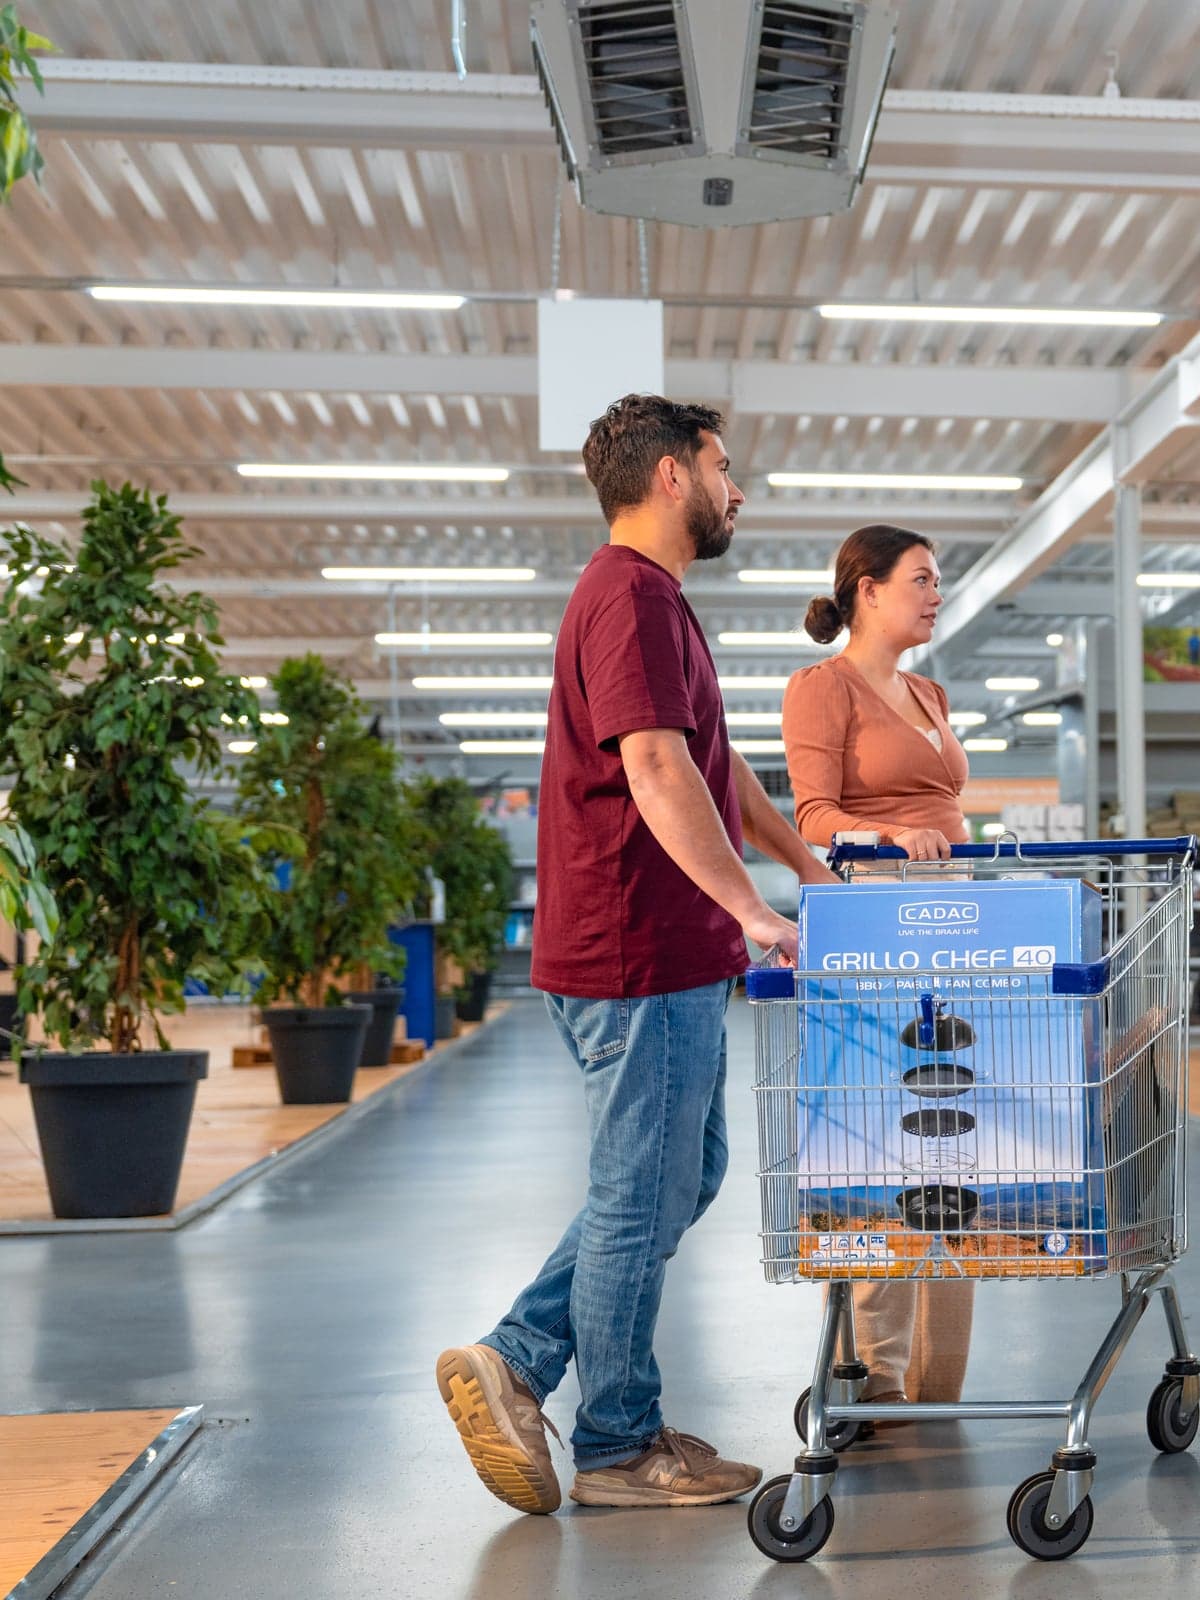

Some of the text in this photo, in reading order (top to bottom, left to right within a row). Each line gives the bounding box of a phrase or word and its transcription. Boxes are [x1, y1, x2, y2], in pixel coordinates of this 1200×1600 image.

[905, 906, 974, 920] CADAC
[963, 927, 979, 935] LIFE
[822, 949, 1052, 970] GRILLO CHEF 40
